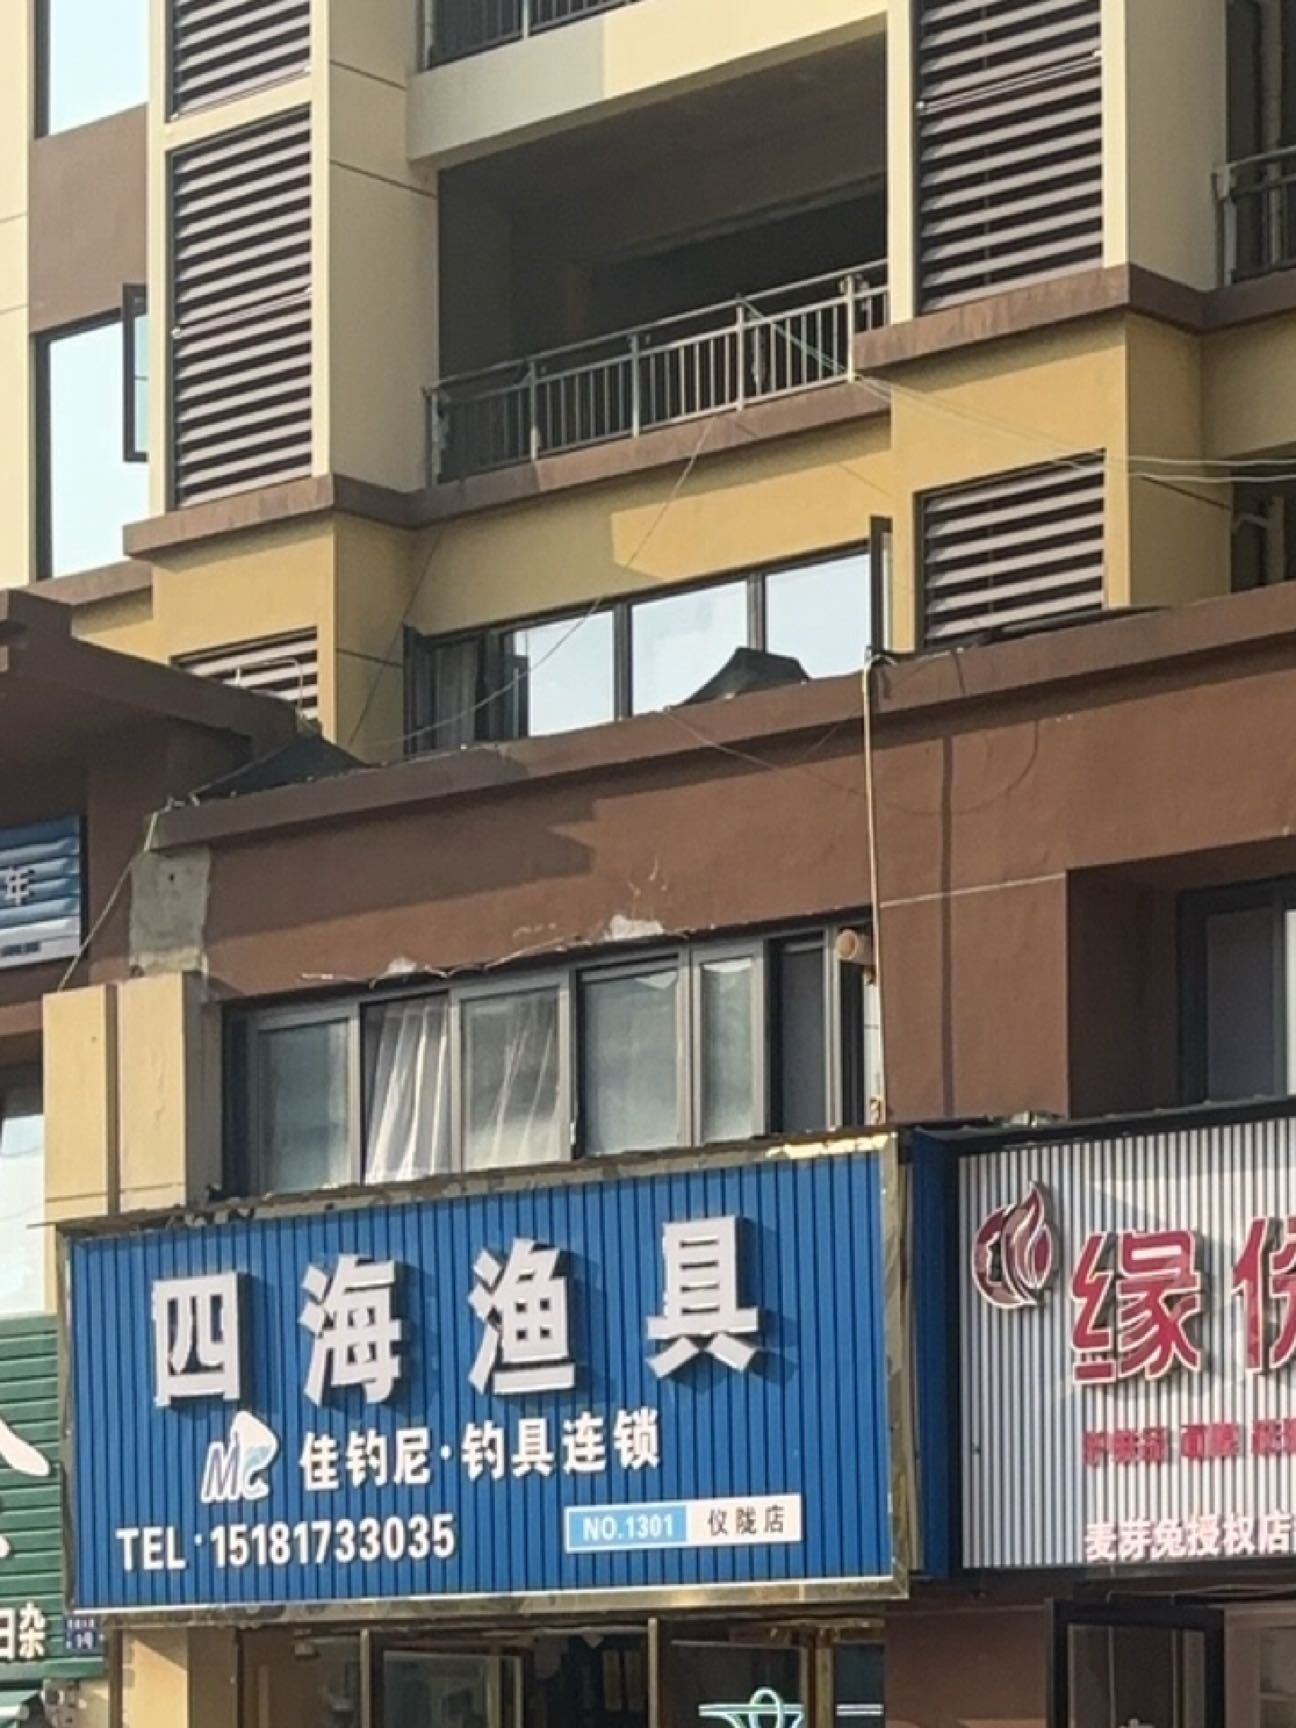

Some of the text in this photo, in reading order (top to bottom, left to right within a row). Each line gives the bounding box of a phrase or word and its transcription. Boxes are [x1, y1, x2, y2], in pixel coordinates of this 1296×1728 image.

[152, 1215, 764, 1407] 四海渔具
[299, 1409, 661, 1493] 佳钓尼·钓具连锁
[582, 1513, 674, 1542] NO.1301
